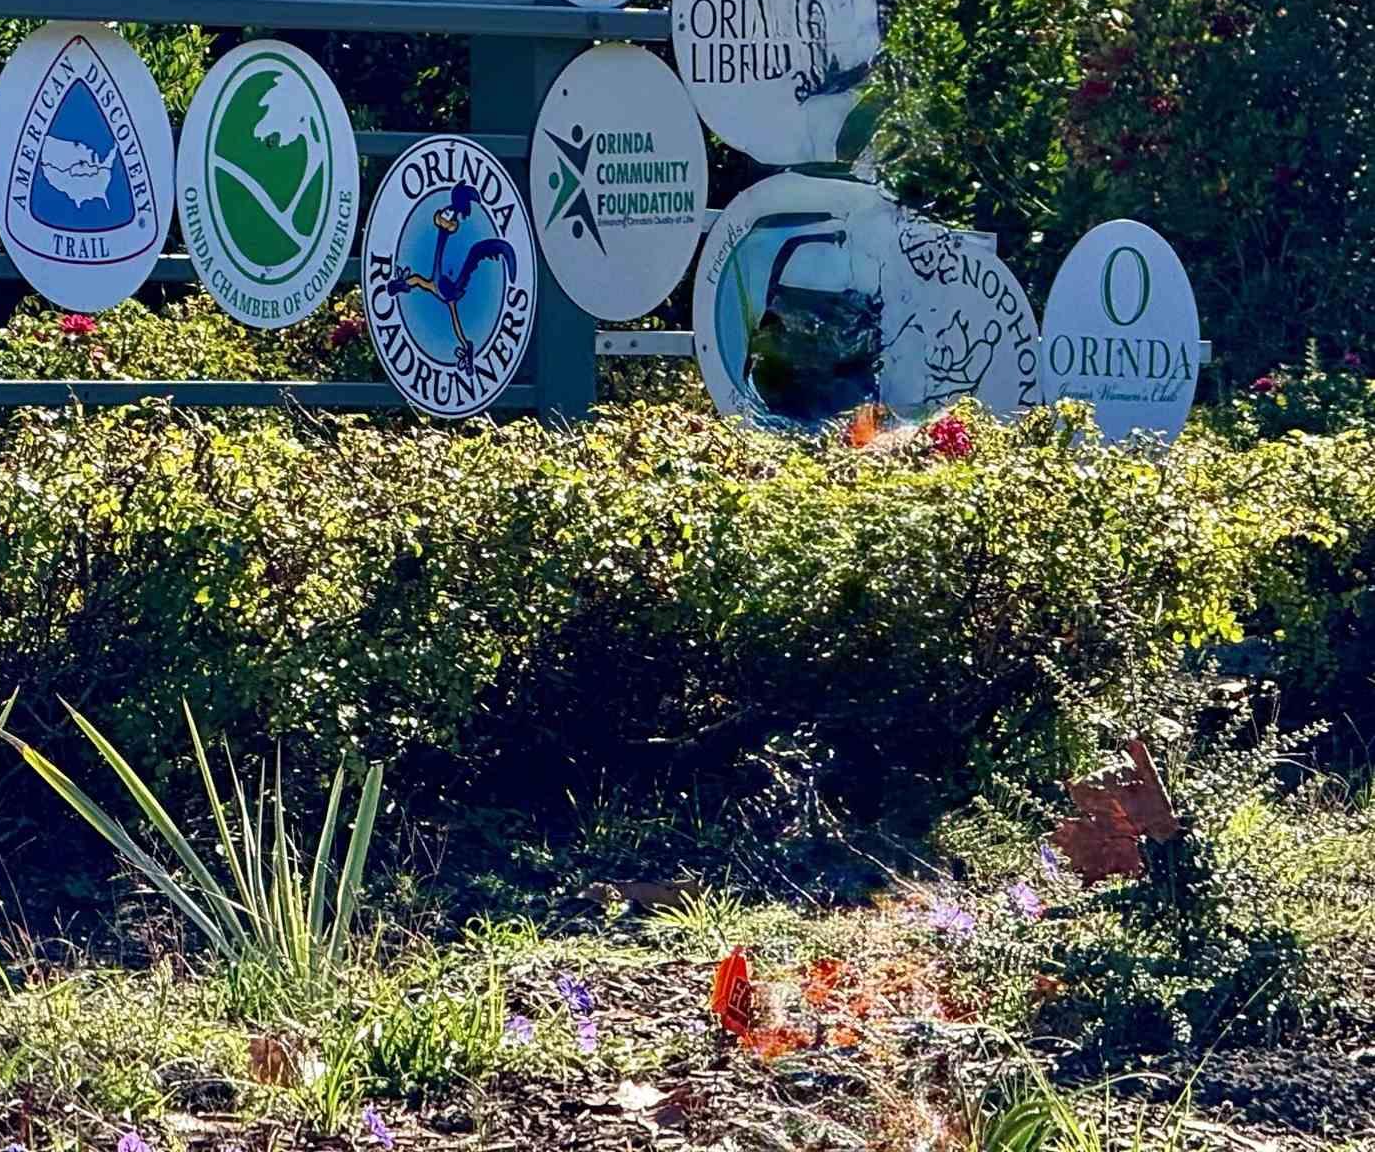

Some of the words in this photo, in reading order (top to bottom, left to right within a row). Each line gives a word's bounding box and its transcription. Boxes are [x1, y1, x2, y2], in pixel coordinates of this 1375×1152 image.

[12, 56, 76, 210] AMERICAN
[84, 63, 152, 214] DISCOVERY
[596, 132, 655, 155] ORINDA
[596, 160, 689, 184] COMMUNITY
[401, 147, 515, 238] ORINDA
[597, 192, 695, 216] FOUNDATION
[52, 234, 110, 258] TRAIL
[184, 186, 212, 273] ORINDA
[212, 269, 280, 320] CHAMBER
[283, 293, 303, 317] OF
[304, 190, 353, 304] COMMERCE
[1100, 246, 1152, 326] O
[370, 251, 529, 407] ROADRUNNERS
[1049, 334, 1193, 380] ORINDA
